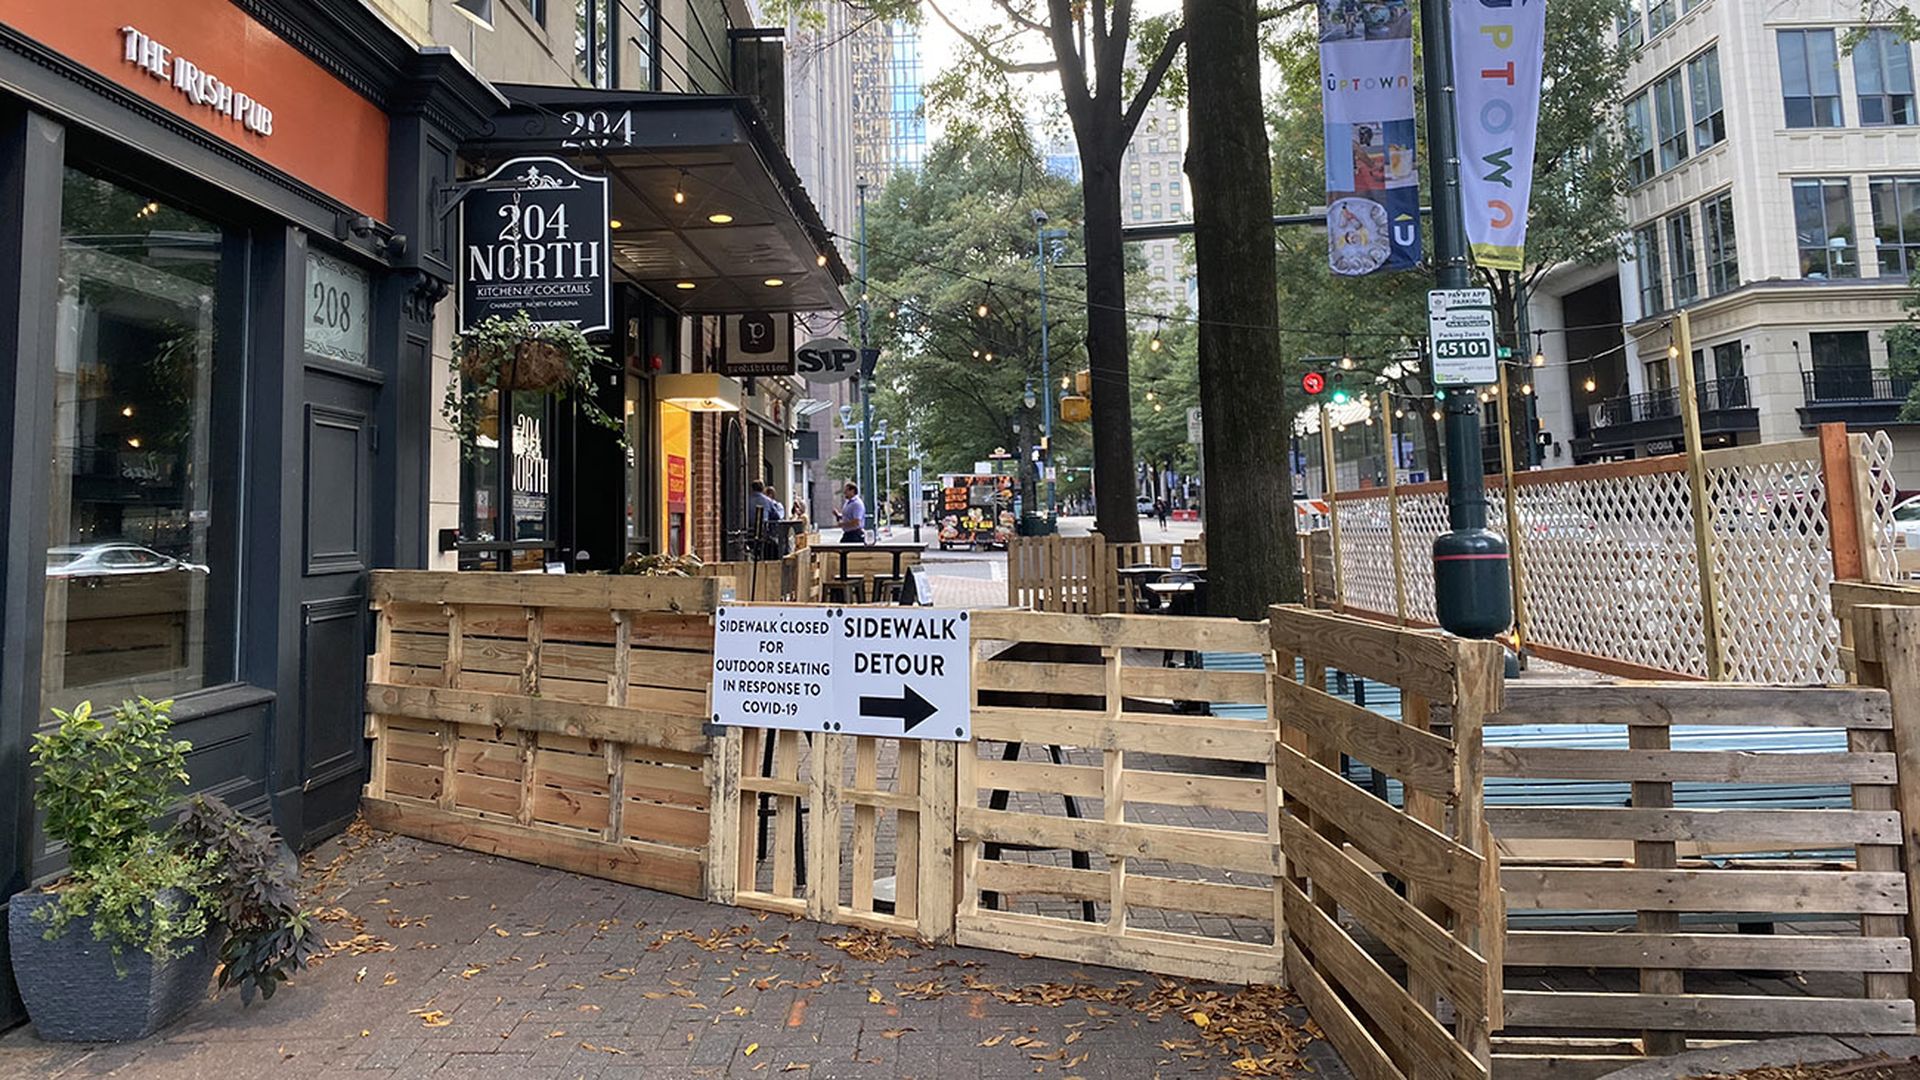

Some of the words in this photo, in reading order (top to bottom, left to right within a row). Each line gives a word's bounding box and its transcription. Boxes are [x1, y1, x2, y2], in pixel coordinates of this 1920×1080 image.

[122, 25, 172, 81] THE
[174, 57, 232, 115] IRISH
[233, 92, 273, 136] PUB
[561, 110, 636, 147] 204
[498, 203, 570, 241] 204
[468, 241, 600, 282] NORTH
[477, 287, 522, 297] KITCHEN
[535, 284, 591, 295] COCKTAILS
[313, 281, 350, 333] 208
[1438, 341, 1487, 355] 45101
[719, 619, 778, 634] SIDEWALK
[780, 620, 829, 635] CLOSED
[843, 617, 957, 640] SIDEWALK
[759, 641, 784, 653] FOR
[715, 659, 774, 674] OUTDOOR
[777, 662, 830, 676] SEATING
[854, 653, 944, 676] DETOUR
[723, 680, 736, 692] IN
[738, 681, 800, 695] RESPONSE
[803, 682, 821, 696] TO
[742, 701, 799, 716] COVID-19
